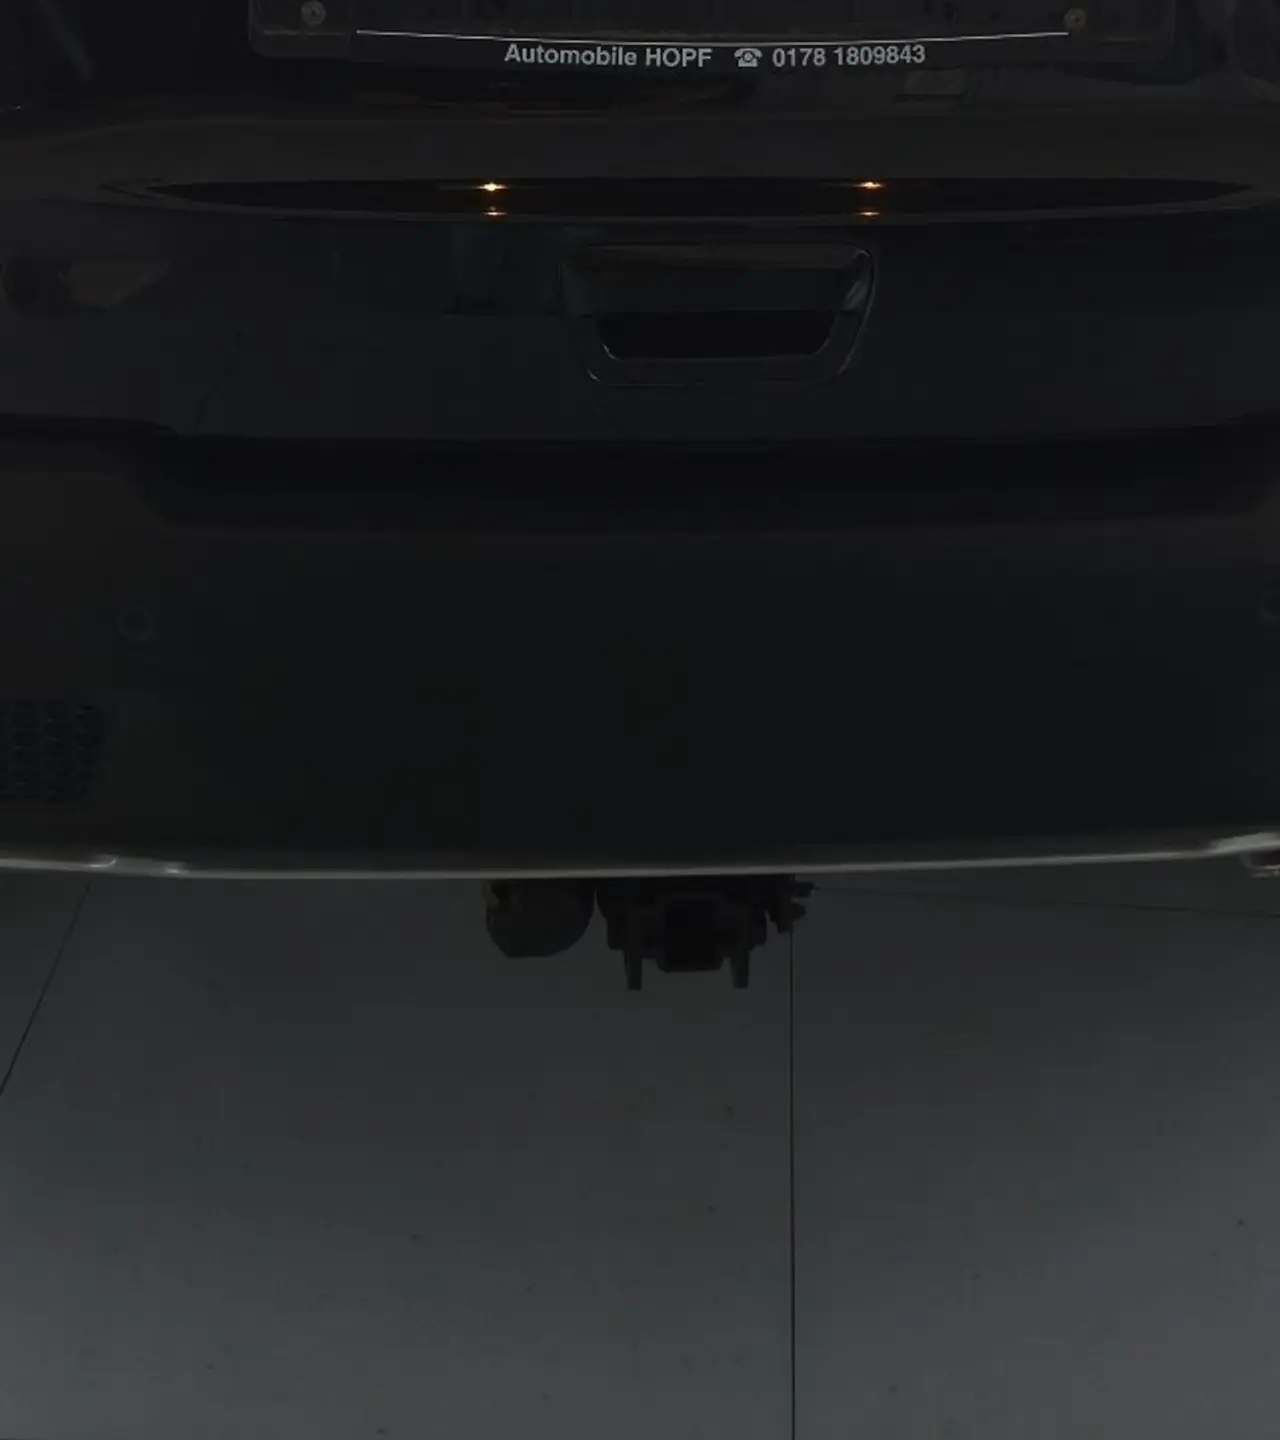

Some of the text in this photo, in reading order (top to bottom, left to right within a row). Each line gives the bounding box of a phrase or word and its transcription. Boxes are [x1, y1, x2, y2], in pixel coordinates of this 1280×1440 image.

[504, 43, 927, 69] Automobile HOPF 0178 1809843
